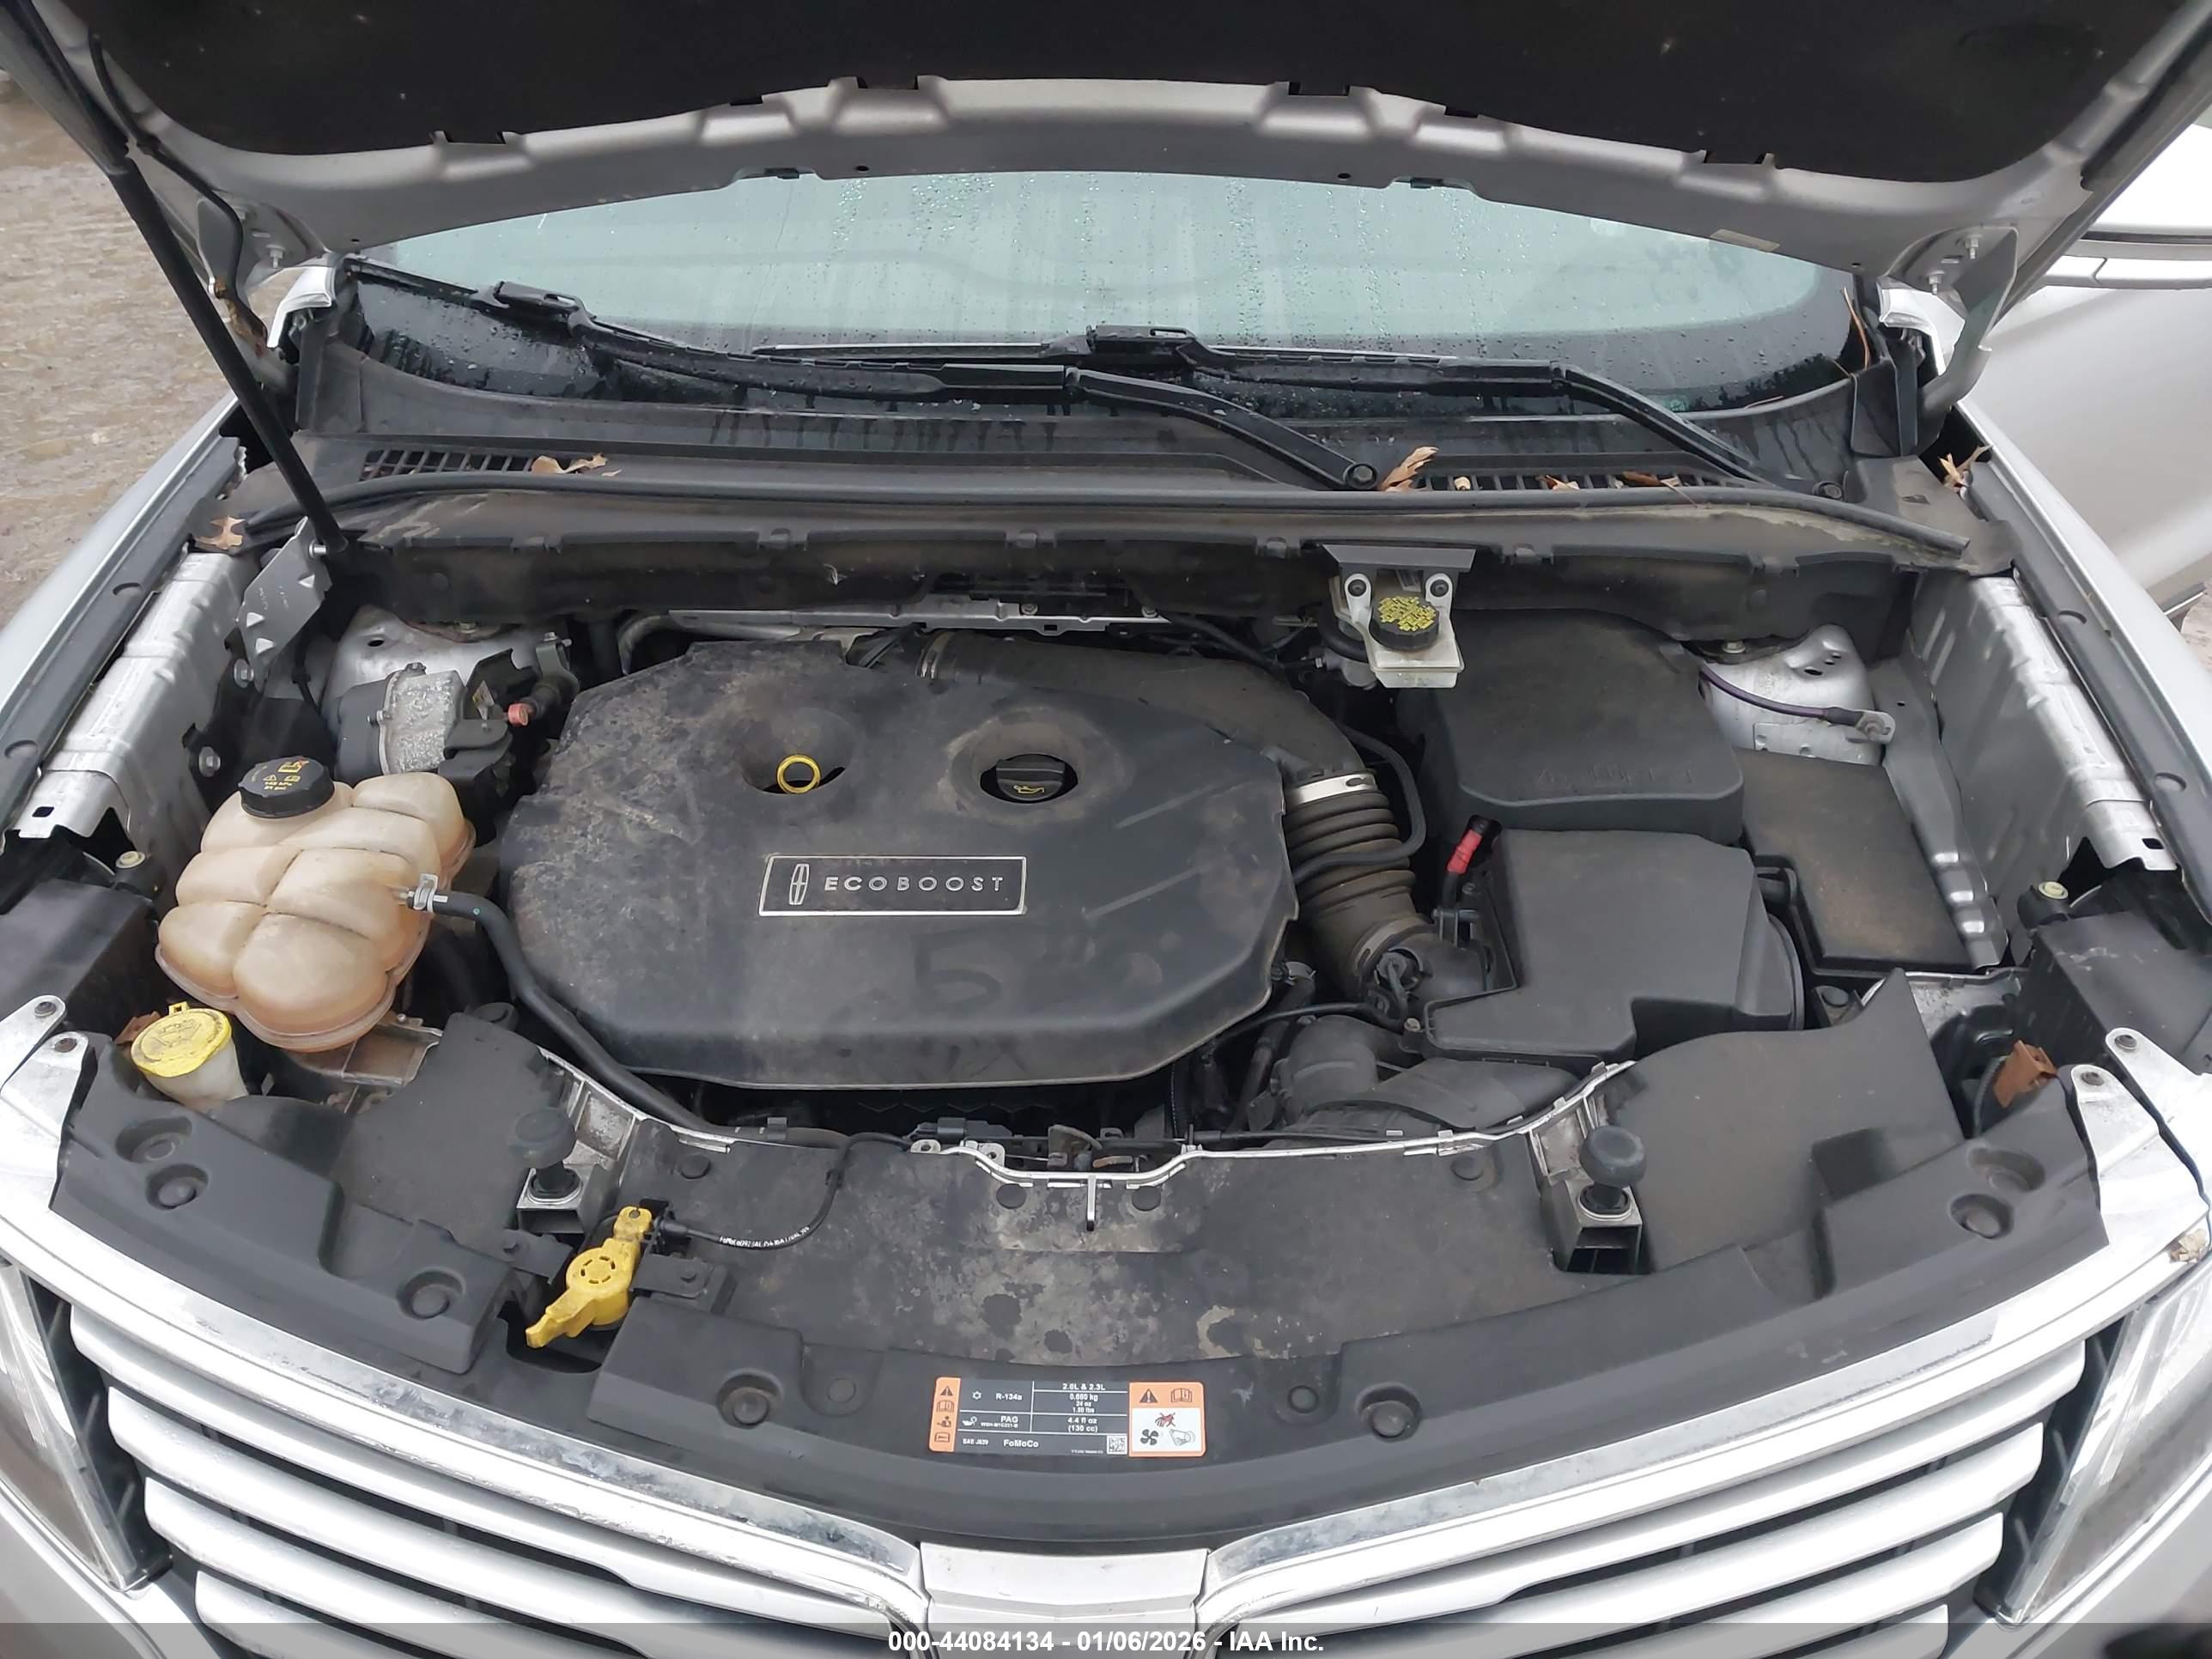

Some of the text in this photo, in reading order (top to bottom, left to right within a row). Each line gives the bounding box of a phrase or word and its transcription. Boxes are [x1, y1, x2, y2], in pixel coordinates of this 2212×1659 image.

[823, 876, 1004, 891] ECOBOOST
[995, 1392, 1023, 1401] R-134a
[1089, 1393, 1098, 1402] kg
[1067, 1425, 1085, 1433] (130
[1003, 1438, 1039, 1449] FoMoCo
